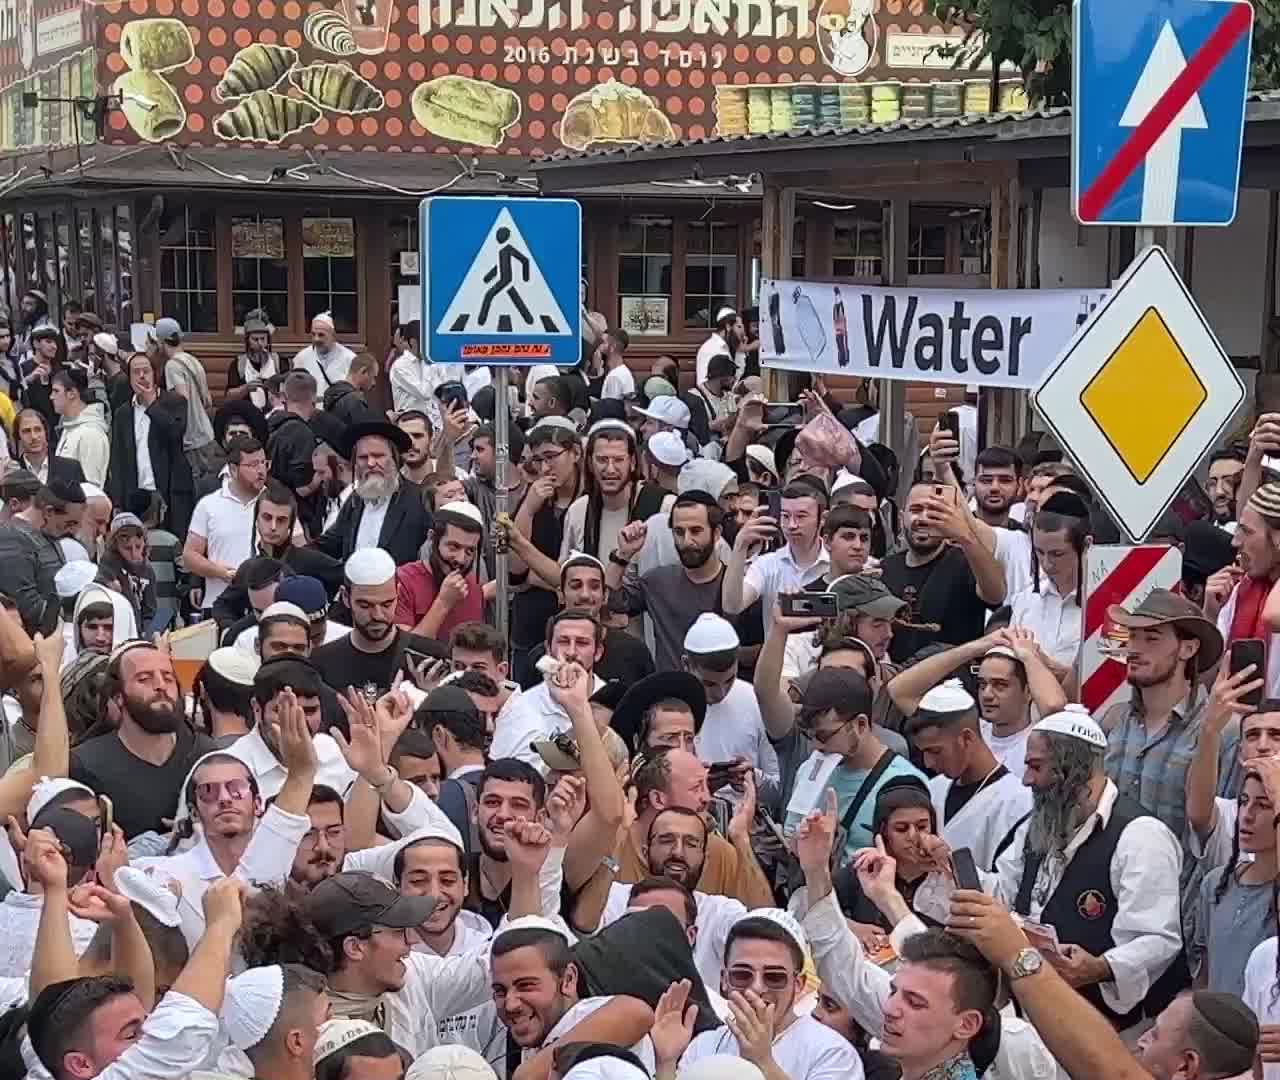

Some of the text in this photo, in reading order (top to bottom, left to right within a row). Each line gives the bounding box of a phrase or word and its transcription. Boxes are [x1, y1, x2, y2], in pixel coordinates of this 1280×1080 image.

[502, 44, 723, 69] נוסד בשנת 2016
[862, 294, 1033, 377] Water
